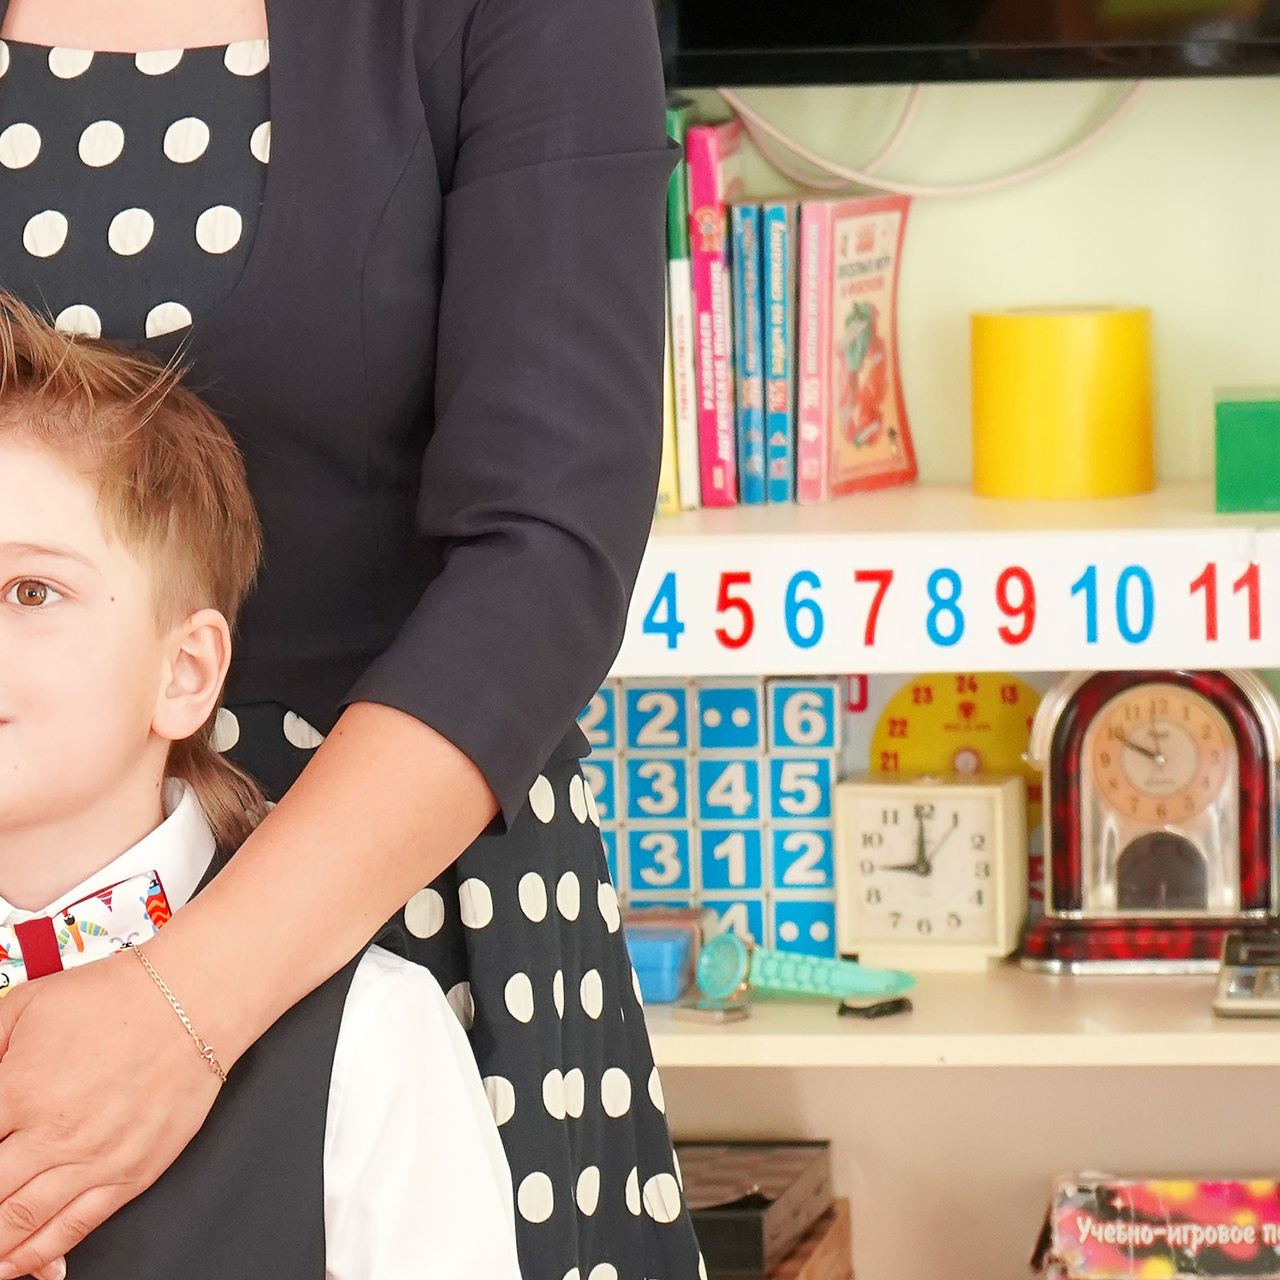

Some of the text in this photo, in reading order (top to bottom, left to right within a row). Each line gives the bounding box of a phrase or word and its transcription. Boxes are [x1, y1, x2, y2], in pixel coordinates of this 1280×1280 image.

[700, 312, 714, 411] РАЗВИВАЕМ
[642, 562, 1261, 649] 4 5 6 7 8 9 10 11
[636, 692, 680, 746] 2
[782, 691, 827, 746] 6
[636, 761, 680, 815] 3
[706, 762, 752, 816] 4
[779, 761, 822, 815] 5
[882, 810, 898, 825] 11
[862, 832, 883, 848] 10
[971, 835, 986, 851] 2
[639, 831, 826, 887] 3 1 2
[975, 861, 990, 880] 3
[888, 911, 902, 928] 7
[1077, 1217, 1255, 1251] Учебно-игровое
